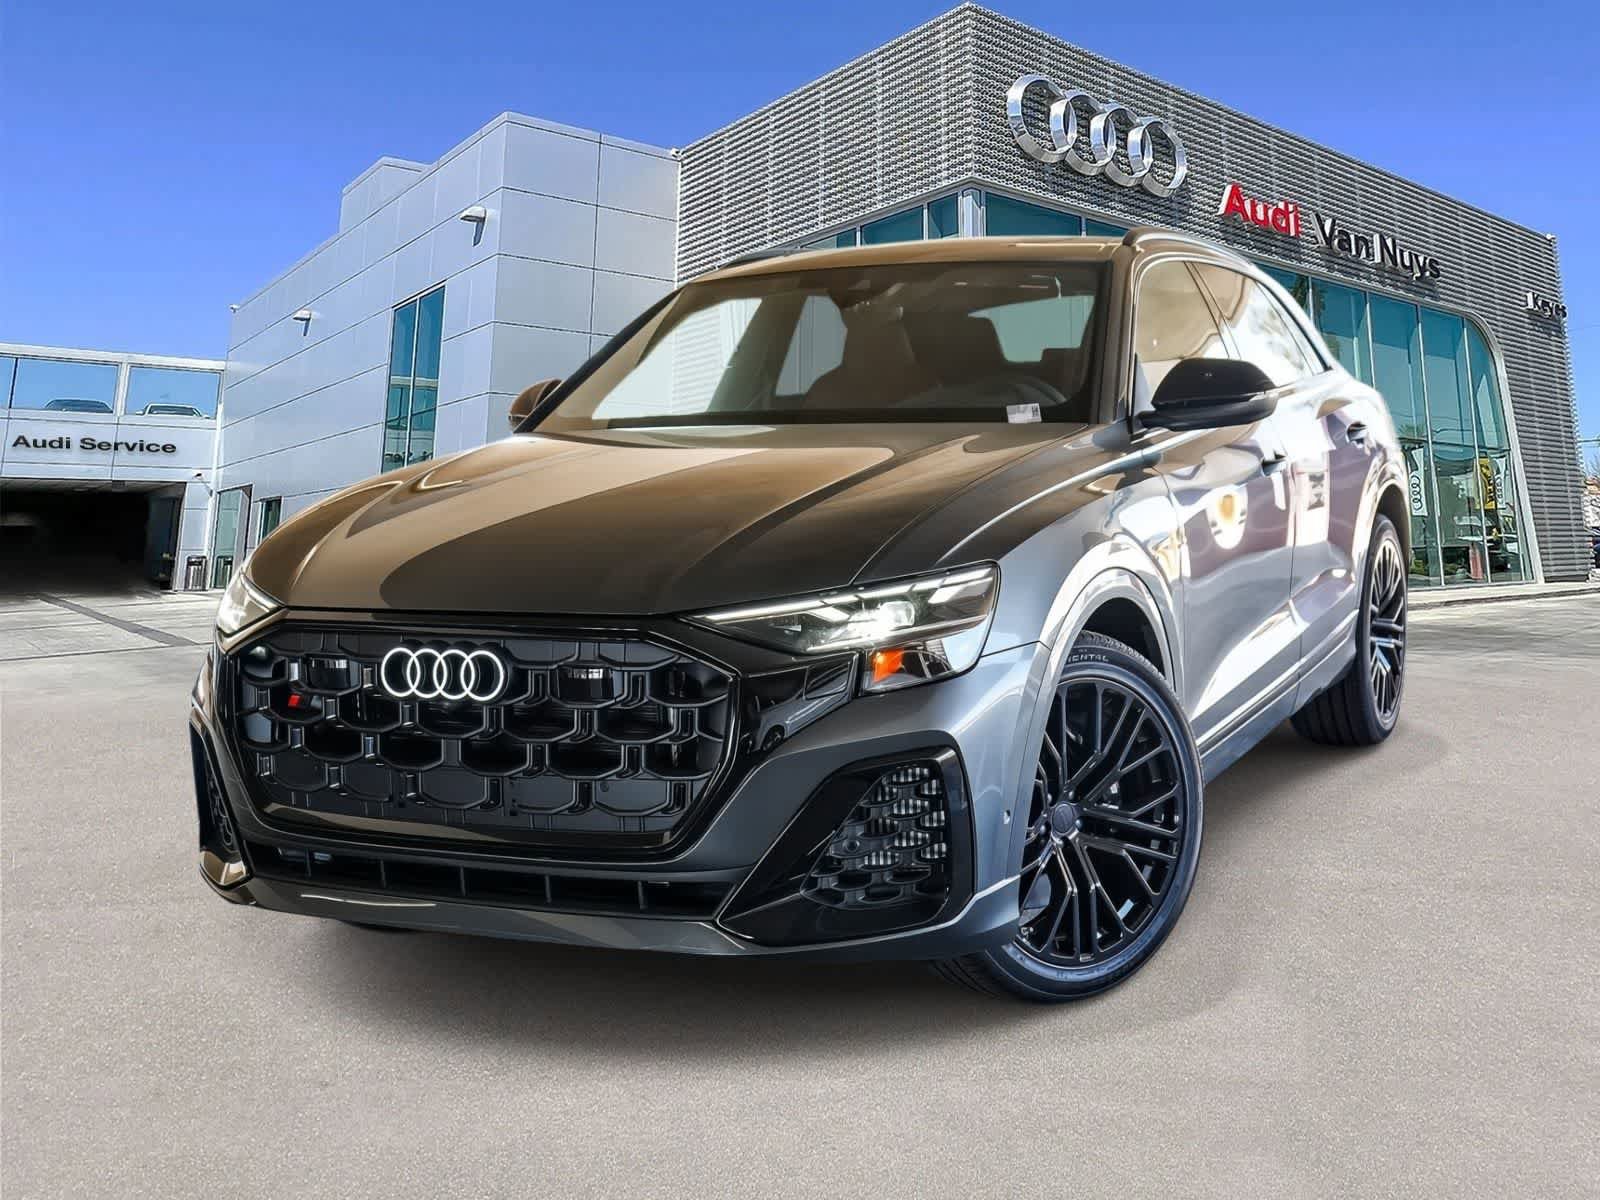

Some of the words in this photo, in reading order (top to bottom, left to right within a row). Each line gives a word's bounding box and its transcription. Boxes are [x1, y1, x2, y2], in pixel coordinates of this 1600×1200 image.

[1218, 182, 1301, 237] Audi
[1312, 211, 1370, 258] Van
[1373, 232, 1442, 280] Nuys
[1526, 292, 1567, 318] Keyes
[12, 435, 71, 449] Audi
[79, 437, 177, 453] Service
